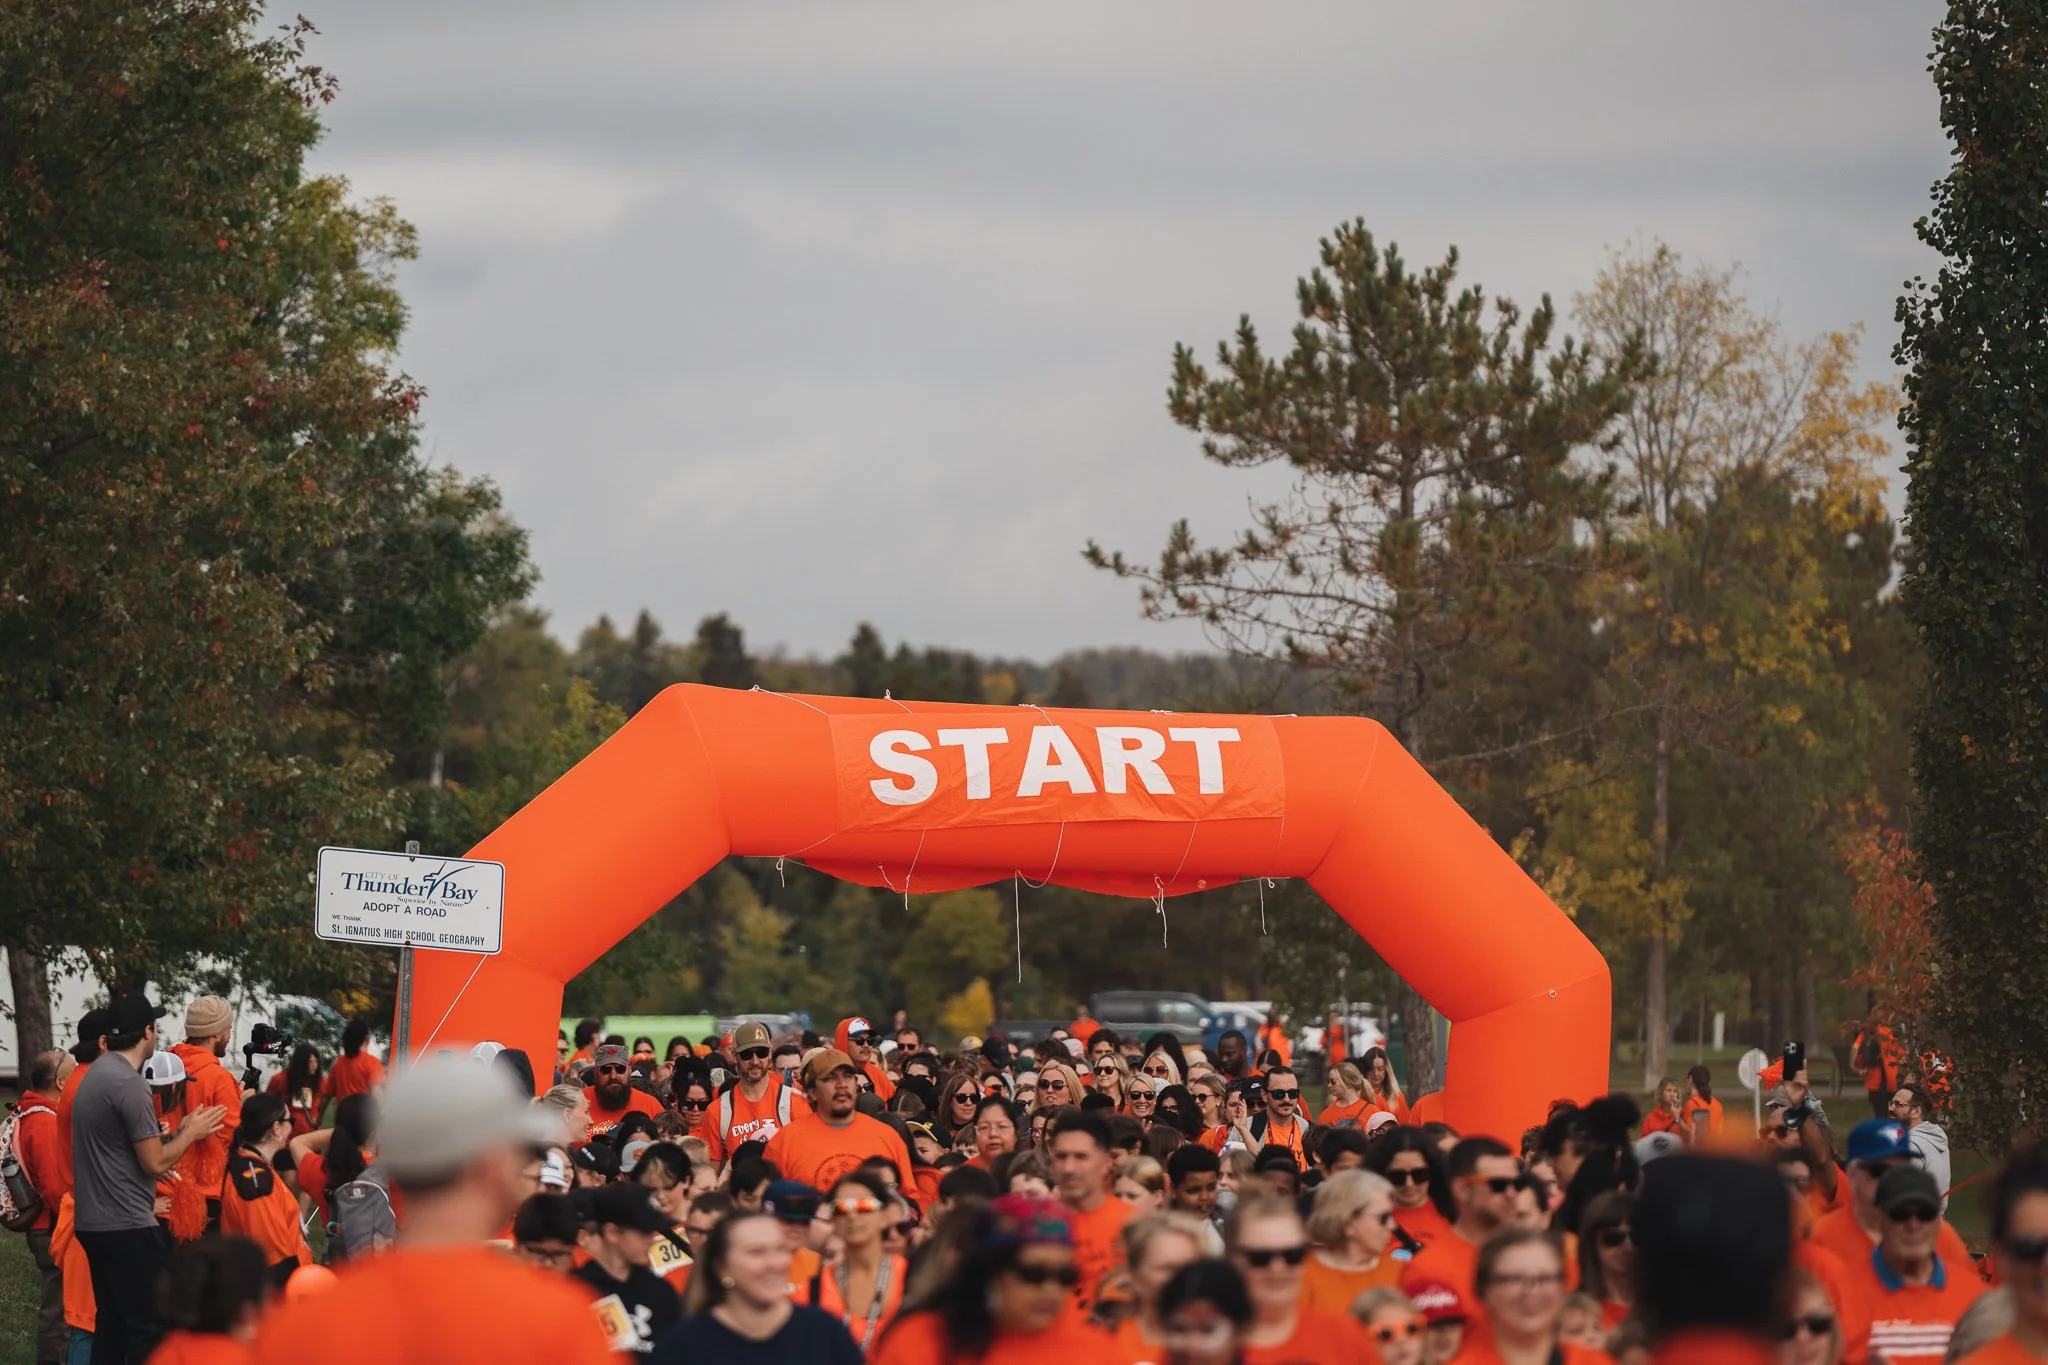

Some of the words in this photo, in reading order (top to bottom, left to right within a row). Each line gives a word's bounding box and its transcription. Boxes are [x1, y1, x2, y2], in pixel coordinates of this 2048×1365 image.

[870, 724, 1241, 806] START
[365, 871, 387, 880] CITY
[388, 873, 400, 881] OF
[340, 871, 429, 897] Thunder
[441, 881, 479, 905] Bay
[362, 902, 400, 914] ADOPT
[404, 905, 412, 915] A
[416, 906, 447, 918] ROAD
[396, 896, 427, 905] Superior
[428, 898, 437, 906] by
[440, 899, 465, 908] Nature
[345, 925, 381, 938] IGNATIUS
[384, 928, 403, 940] HIGH
[405, 930, 436, 943] SCHOOL
[439, 933, 486, 946] GEOGRAPHY
[731, 1118, 760, 1137] Every
